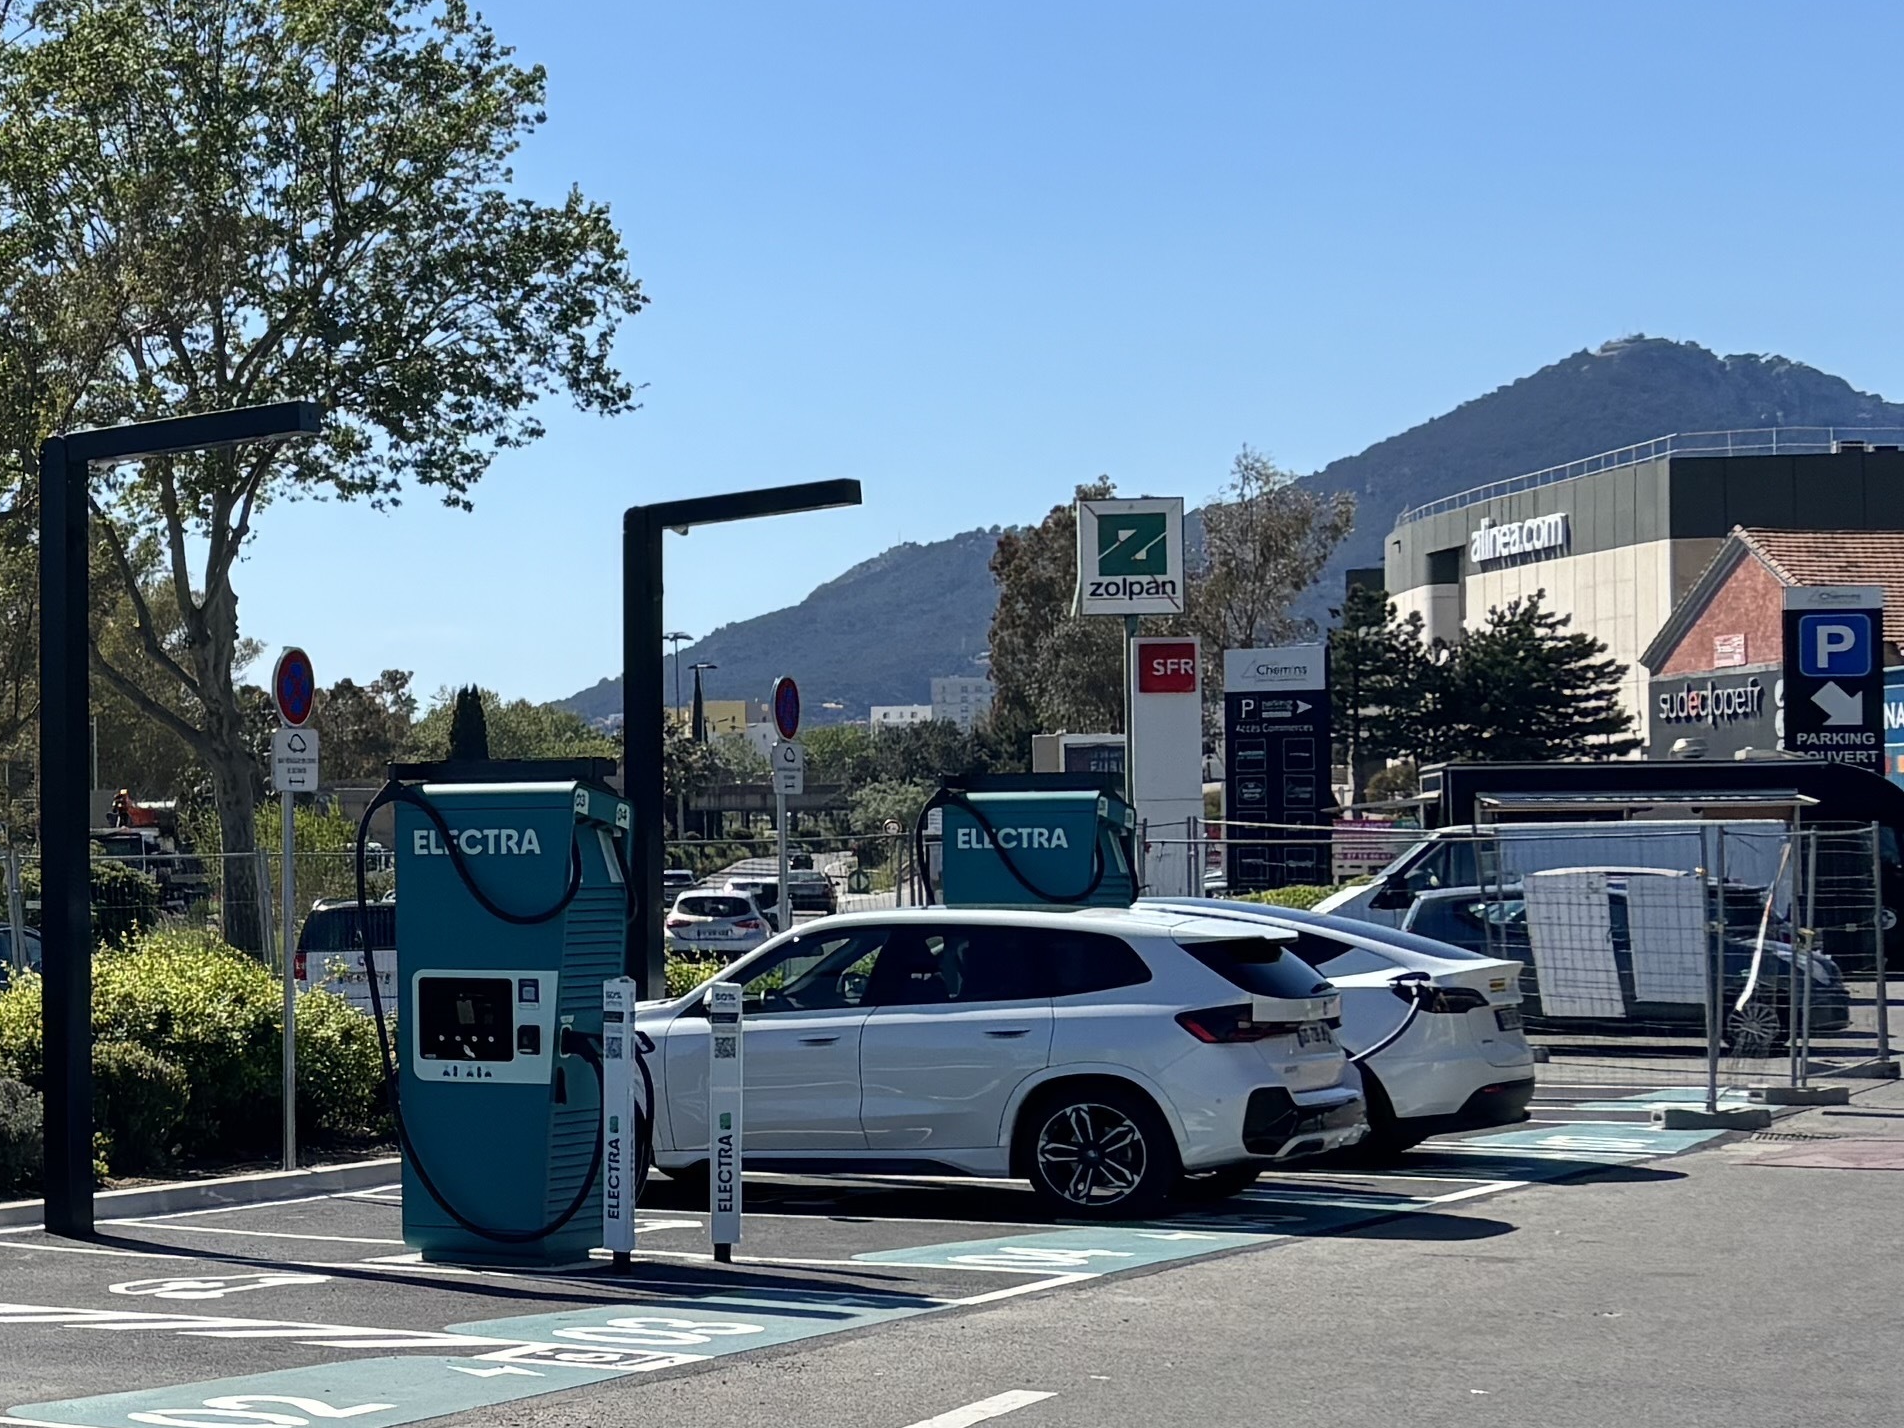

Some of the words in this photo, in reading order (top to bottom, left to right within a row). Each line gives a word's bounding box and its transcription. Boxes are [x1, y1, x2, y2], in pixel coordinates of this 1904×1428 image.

[1471, 513, 1565, 562] alinea.com
[1089, 578, 1176, 600] zolpan
[1152, 659, 1193, 676] SFR
[1816, 624, 1856, 669] P
[1659, 677, 1762, 724] sudeclope.fr
[1796, 733, 1876, 745] PARKING
[608, 1137, 620, 1219] ELECTRA
[717, 1134, 733, 1212] ELECTRA
[552, 1317, 765, 1345] 03
